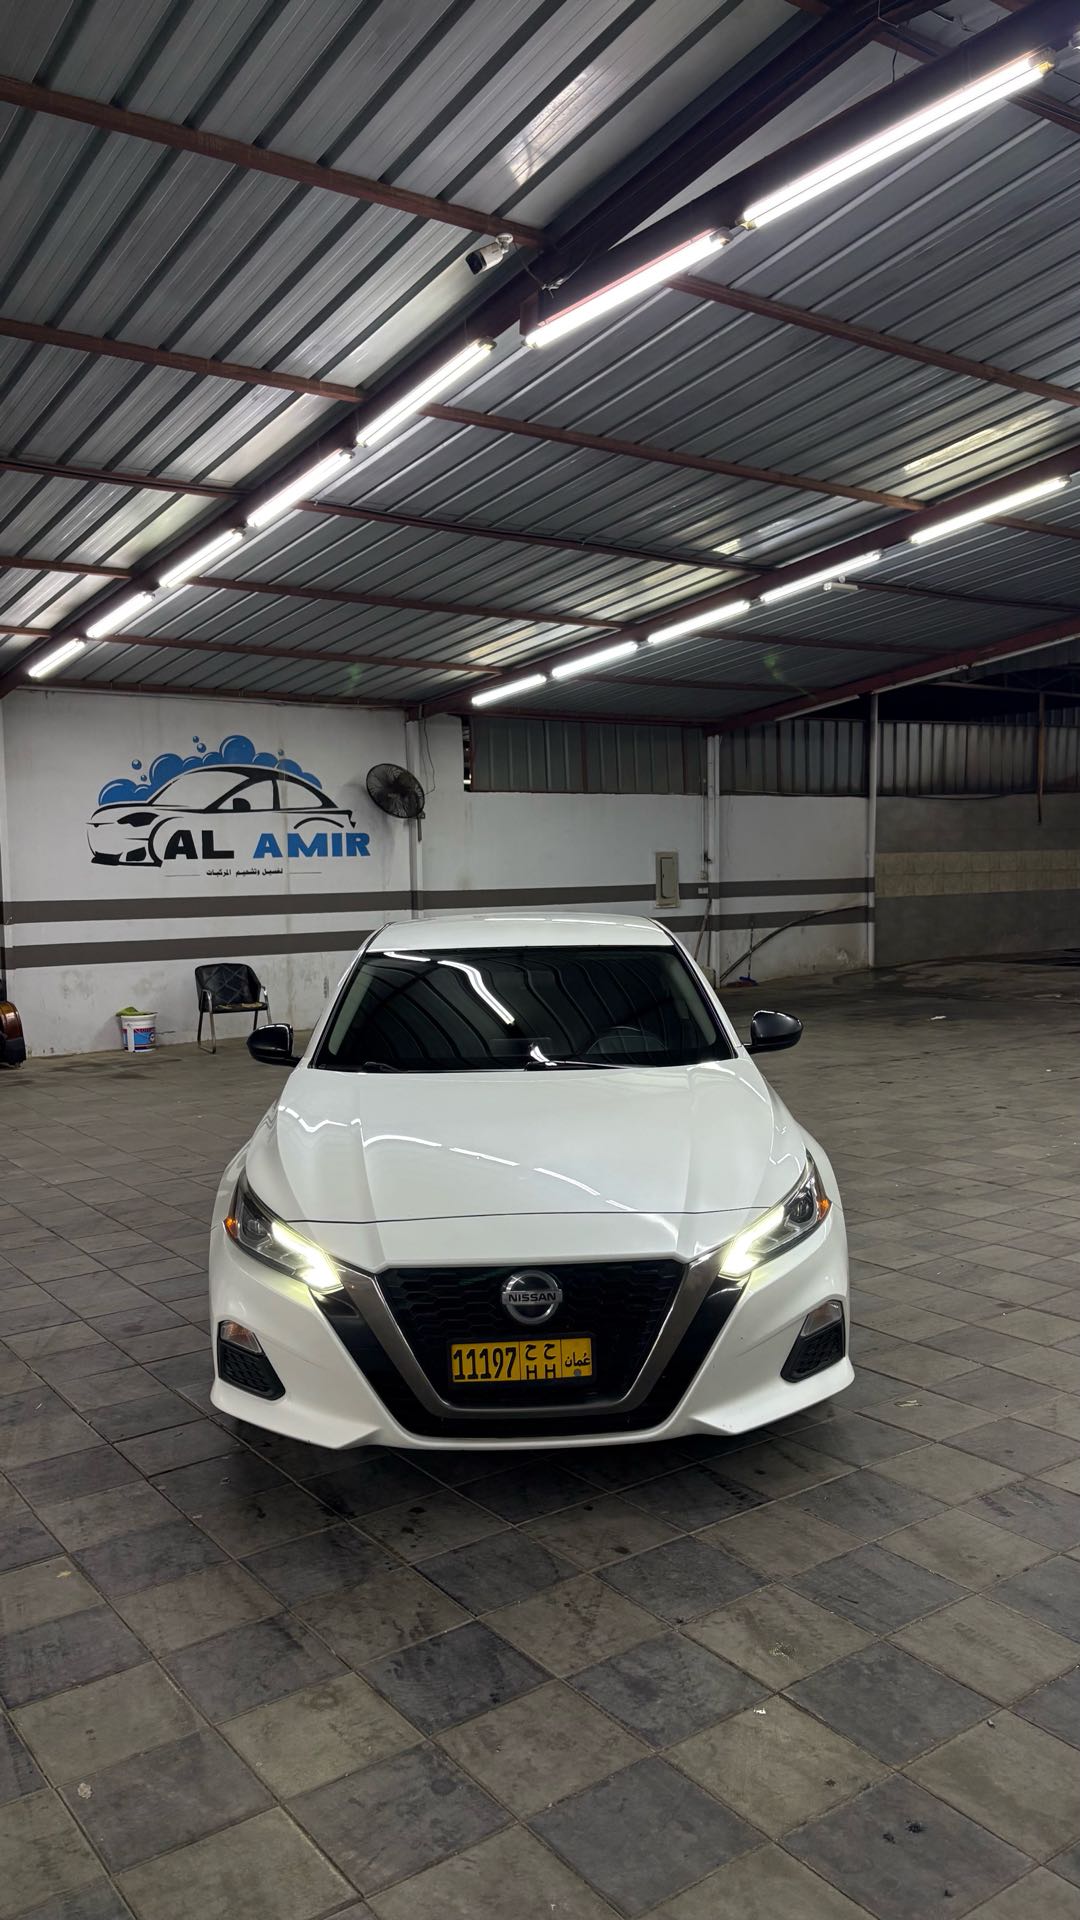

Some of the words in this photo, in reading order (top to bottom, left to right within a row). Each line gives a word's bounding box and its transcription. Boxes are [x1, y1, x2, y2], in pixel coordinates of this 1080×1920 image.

[163, 829, 235, 859] AL
[252, 832, 370, 858] AMIR
[206, 868, 231, 878] المركبات
[508, 1293, 556, 1303] NISSAN
[453, 1347, 516, 1380] 11197
